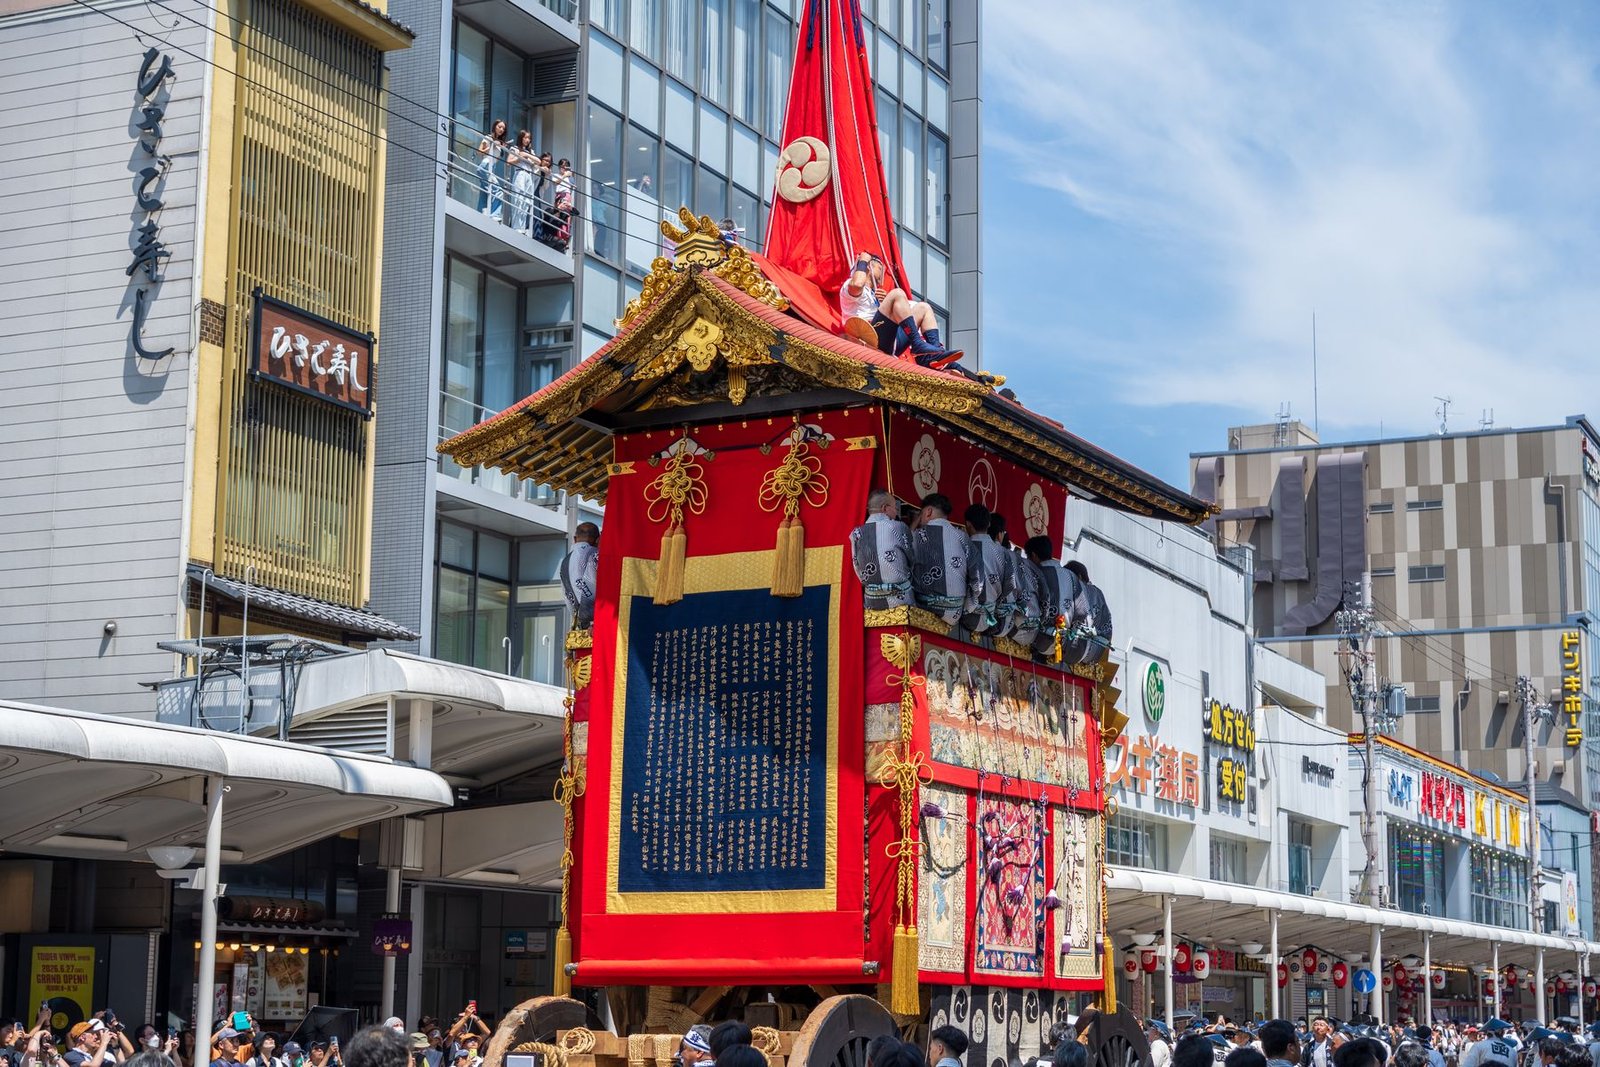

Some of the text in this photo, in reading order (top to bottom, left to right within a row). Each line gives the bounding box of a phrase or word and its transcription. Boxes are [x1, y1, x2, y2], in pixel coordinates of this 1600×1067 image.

[126, 47, 175, 361] ひさご寿し
[270, 326, 368, 391] ひさご寿し
[1210, 700, 1256, 752] 処方せん
[1109, 734, 1200, 807] スギ薬局
[1221, 760, 1247, 803] 受付
[1388, 768, 1413, 803] SLOT
[36, 974, 89, 984] GRAND OPEN!!
[59, 953, 77, 961] VINYL
